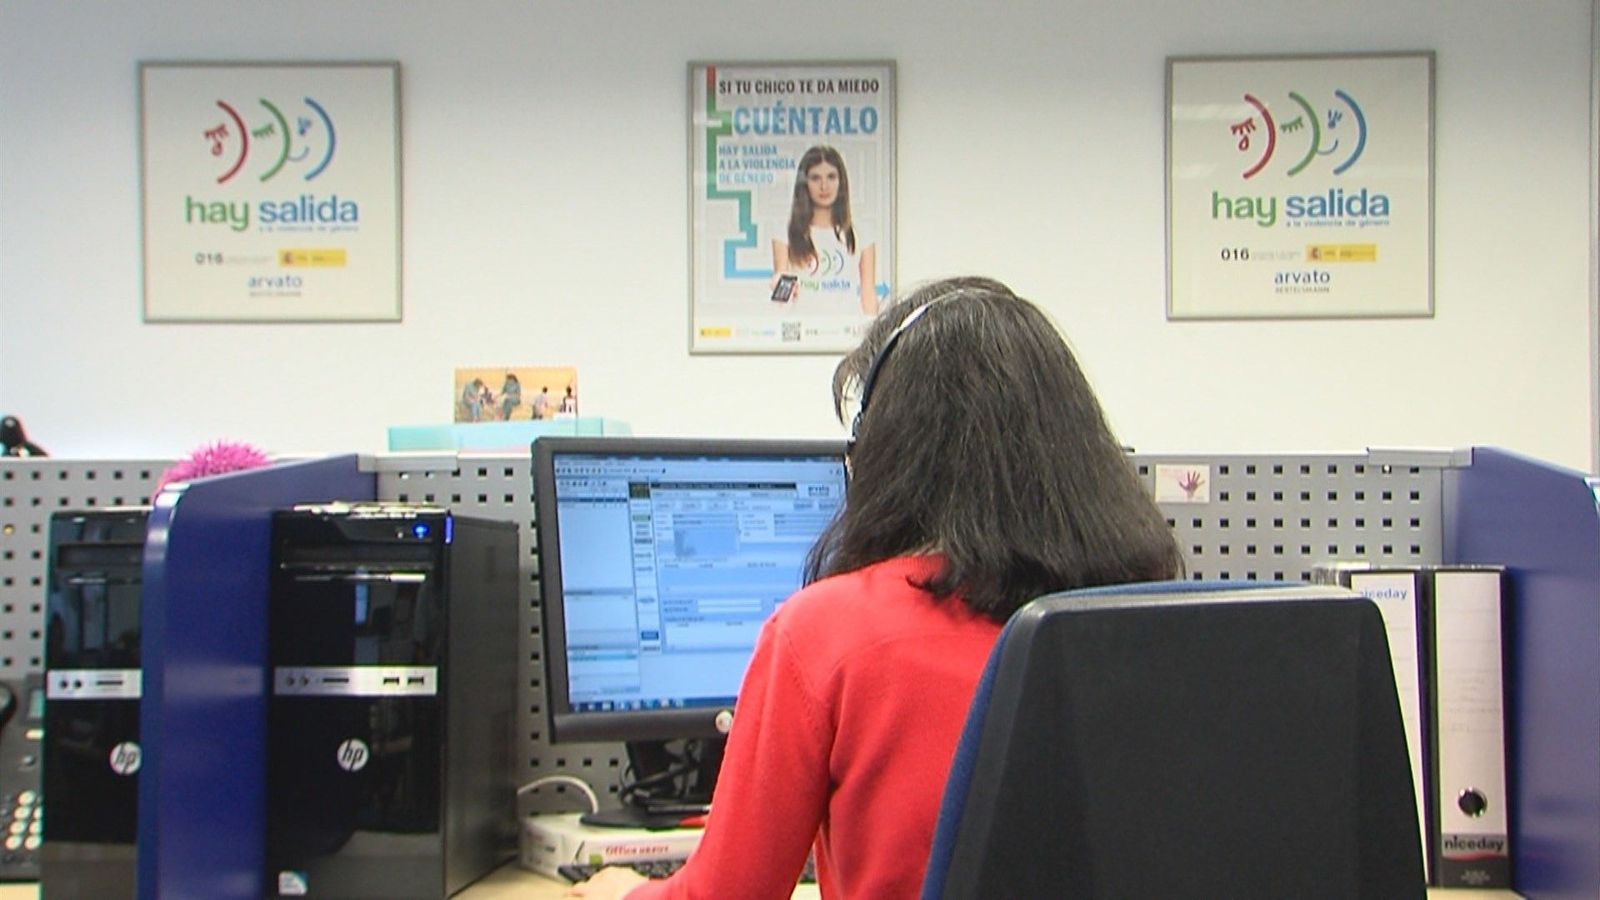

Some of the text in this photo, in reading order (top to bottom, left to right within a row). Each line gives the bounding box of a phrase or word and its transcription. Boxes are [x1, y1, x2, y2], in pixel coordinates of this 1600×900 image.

[719, 79, 879, 94] SI TU CHICO TE DA MIEDO
[733, 100, 879, 135] CUÉNTALO
[719, 144, 777, 155] HAY SALIDA
[719, 157, 796, 169] A LA VIOLENCIA
[186, 193, 359, 232] hay salida
[1211, 187, 1390, 228] hay salida
[194, 252, 223, 265] 016
[1221, 247, 1250, 261] 016
[247, 274, 303, 289] arvato
[1274, 269, 1331, 284] arvato
[114, 742, 138, 775] hp
[342, 740, 366, 771] hp
[1444, 834, 1504, 851] niceday
